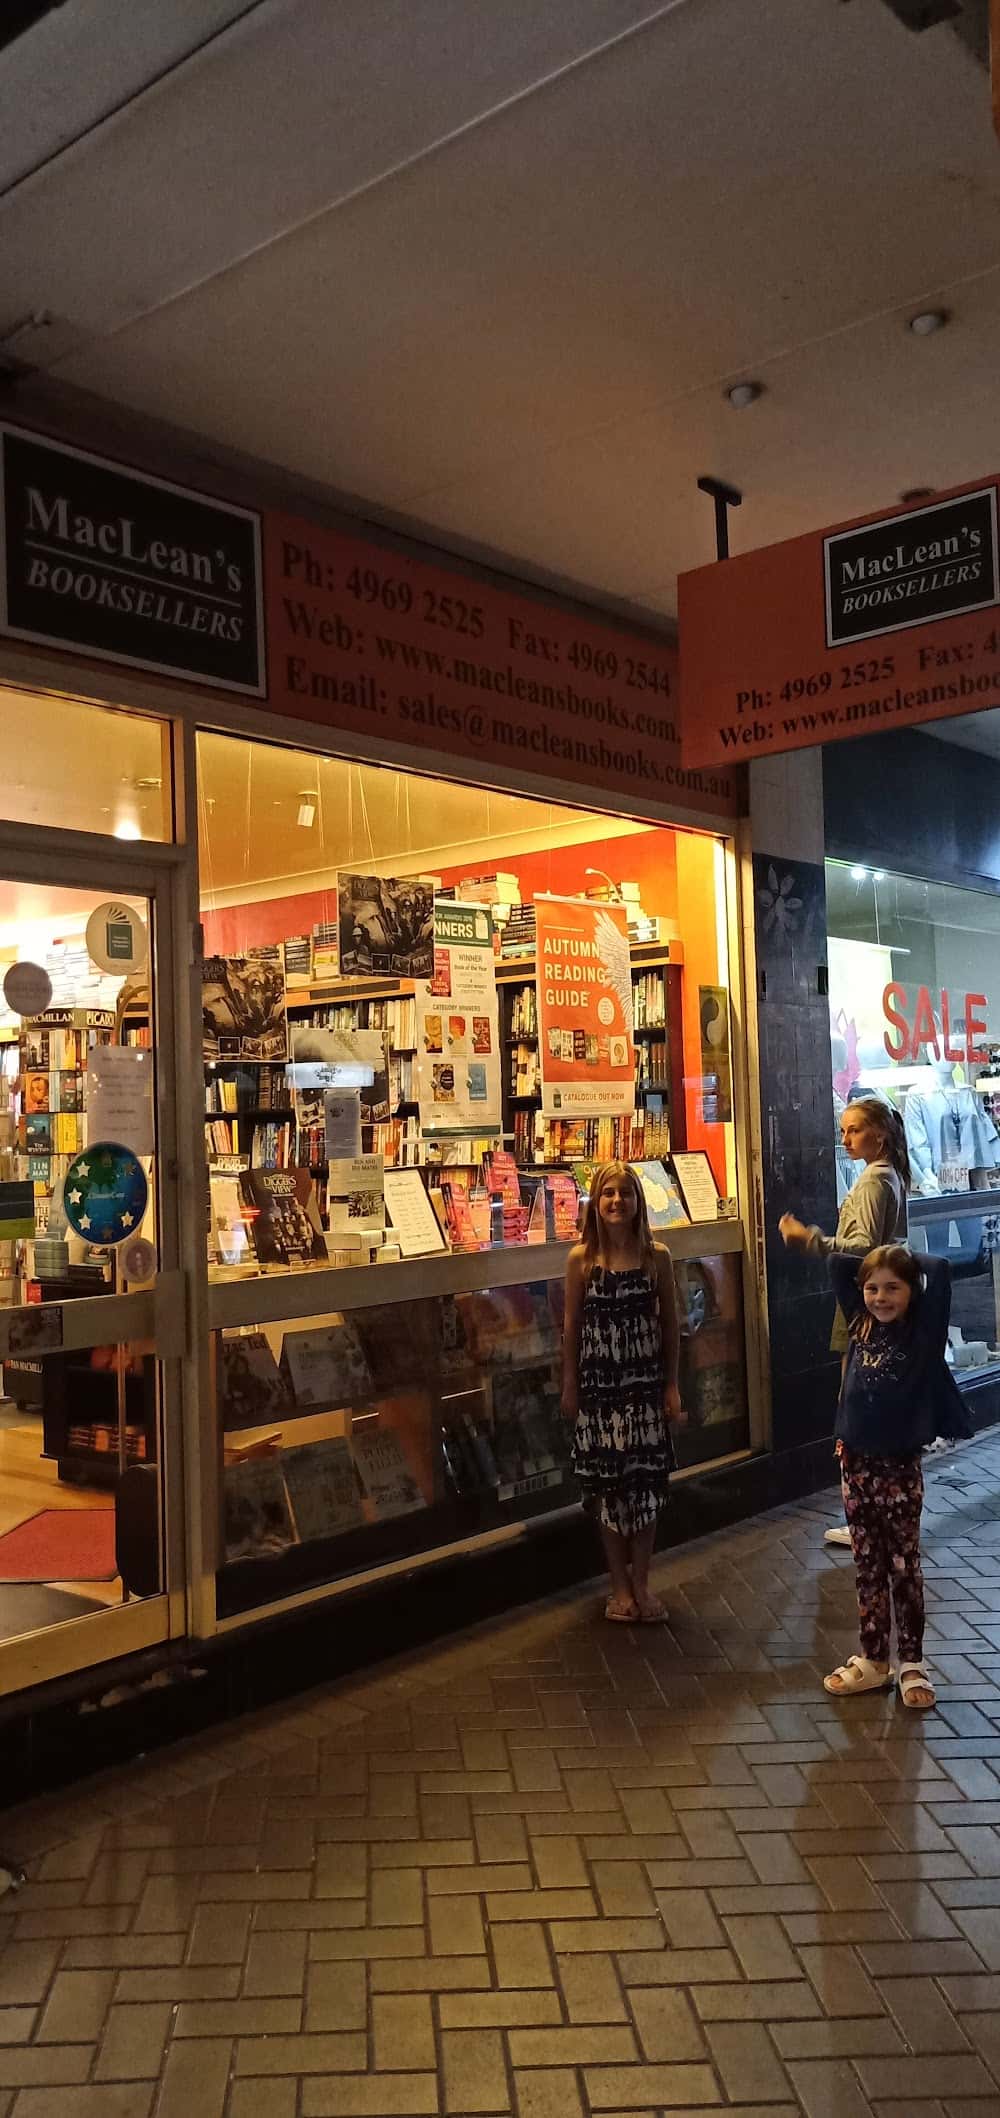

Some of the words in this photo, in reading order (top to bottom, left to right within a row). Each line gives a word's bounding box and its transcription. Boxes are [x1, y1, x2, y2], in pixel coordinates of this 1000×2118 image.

[24, 485, 242, 593] MacLean's
[841, 526, 982, 585] MacLean's
[27, 557, 243, 642] BOOKSELLERS
[842, 561, 982, 615] BOOKSELLERS
[282, 539, 333, 592] Ph:
[346, 565, 413, 615] 4969
[423, 588, 486, 640] 2525
[507, 616, 560, 664] Fax:
[567, 640, 618, 680] 4969
[626, 656, 670, 697] 2544
[282, 597, 364, 655] Web:
[286, 655, 387, 714] Email:
[736, 689, 772, 714] Ph:
[779, 671, 833, 703] 4969
[840, 656, 896, 690] 2525
[918, 642, 974, 671] Fax:
[719, 718, 774, 749] Web:
[544, 937, 600, 959] AUTUMN
[544, 962, 606, 984] READING
[545, 988, 589, 1007] GUIDE
[882, 982, 989, 1064] SALE
[564, 1092, 597, 1101] CATALOGUE
[598, 1092, 610, 1101] OUT
